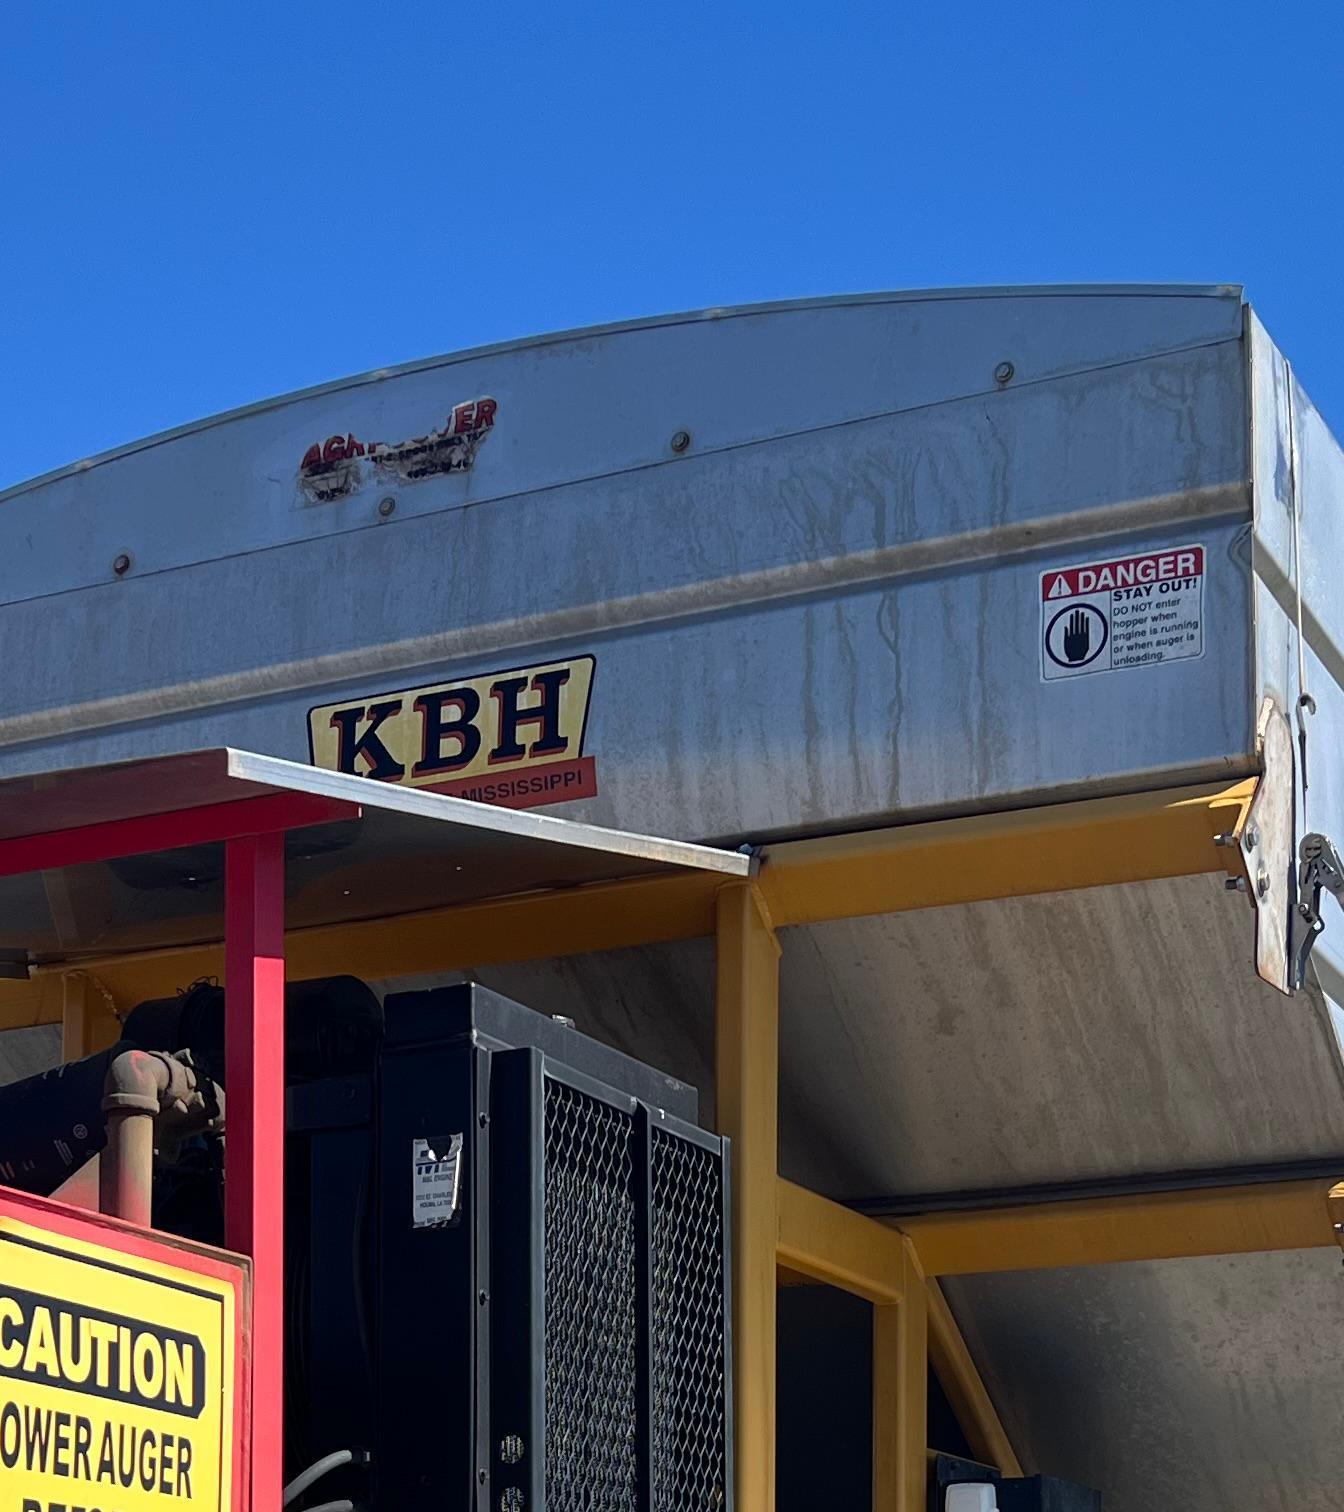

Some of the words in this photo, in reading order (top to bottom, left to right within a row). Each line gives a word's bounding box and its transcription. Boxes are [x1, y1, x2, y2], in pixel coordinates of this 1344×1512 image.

[1078, 552, 1196, 594] DANGER
[1113, 584, 1154, 602] STAY
[1158, 577, 1198, 594] OUT!
[1113, 606, 1129, 617] DO
[1131, 601, 1153, 613] NOT
[1155, 598, 1182, 609] enter
[1113, 616, 1149, 630] hopper
[1150, 611, 1178, 623] when
[1113, 629, 1147, 642] engine
[1149, 626, 1158, 636] is
[1160, 620, 1199, 632] running
[1113, 645, 1124, 654] or
[1126, 640, 1154, 652] when
[1155, 635, 1185, 647] auger
[1186, 632, 1195, 641] is
[330, 668, 570, 783] KBH
[96, 1421, 193, 1499] AUGER
